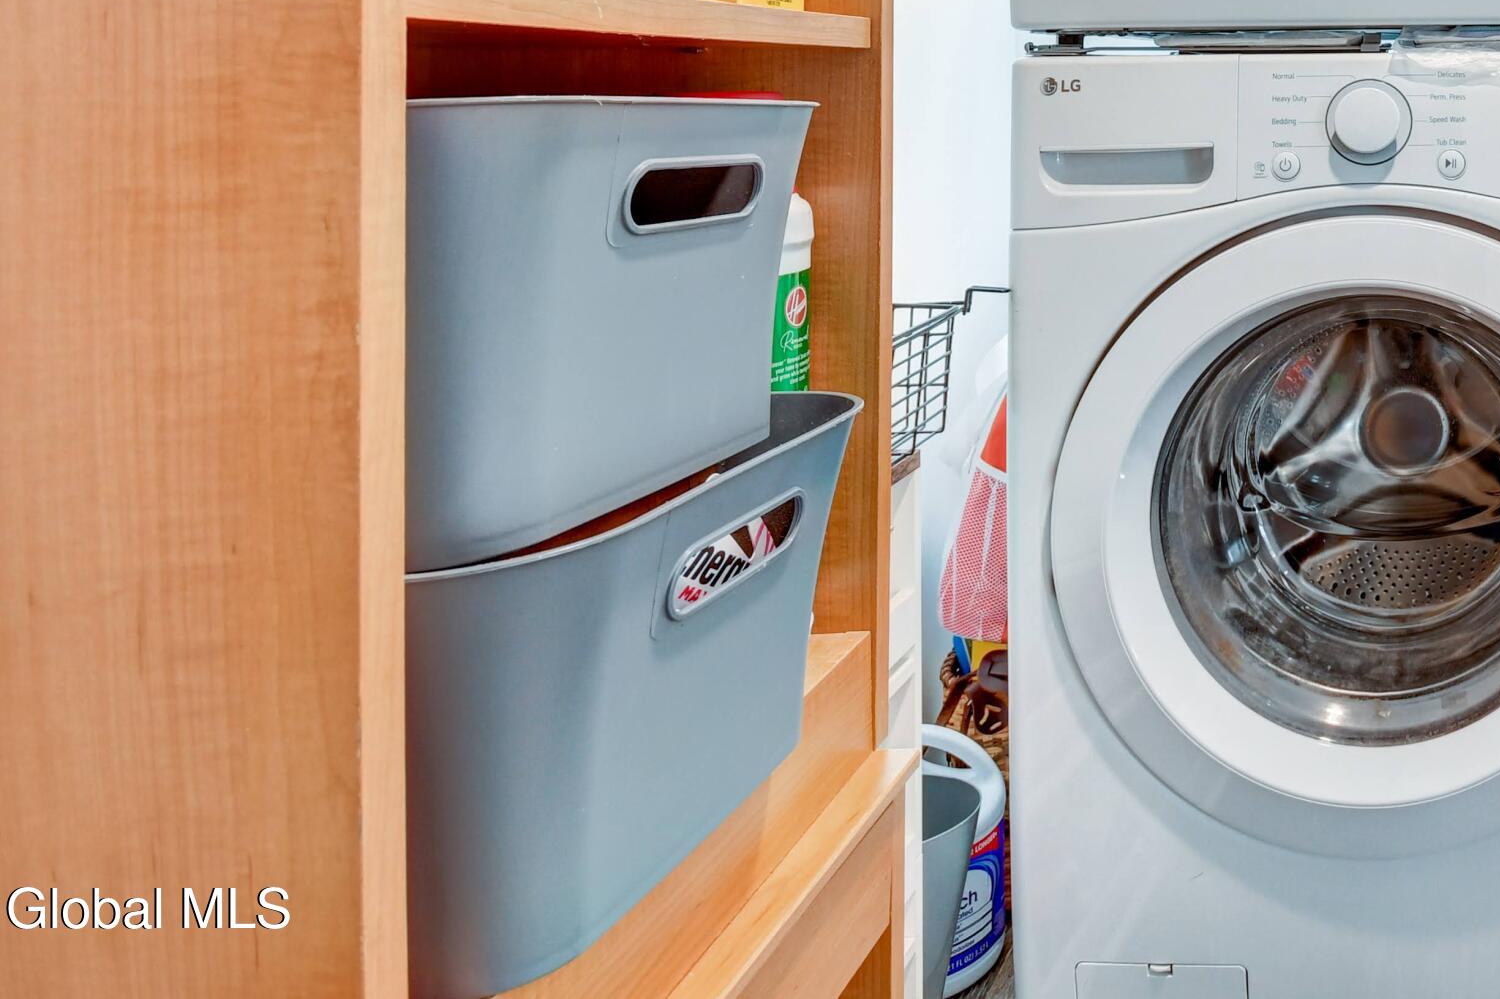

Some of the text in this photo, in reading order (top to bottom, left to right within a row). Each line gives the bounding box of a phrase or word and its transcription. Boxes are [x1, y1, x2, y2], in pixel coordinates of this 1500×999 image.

[1437, 71, 1466, 79] Delicates
[1061, 79, 1081, 93] LG
[1272, 94, 1308, 103] Heavy Duty
[1448, 93, 1466, 101] Press
[1271, 118, 1297, 126] Bedding
[1429, 115, 1466, 124] Speed Wash
[1436, 138, 1467, 146] Tub Clean
[678, 585, 708, 603] MA
